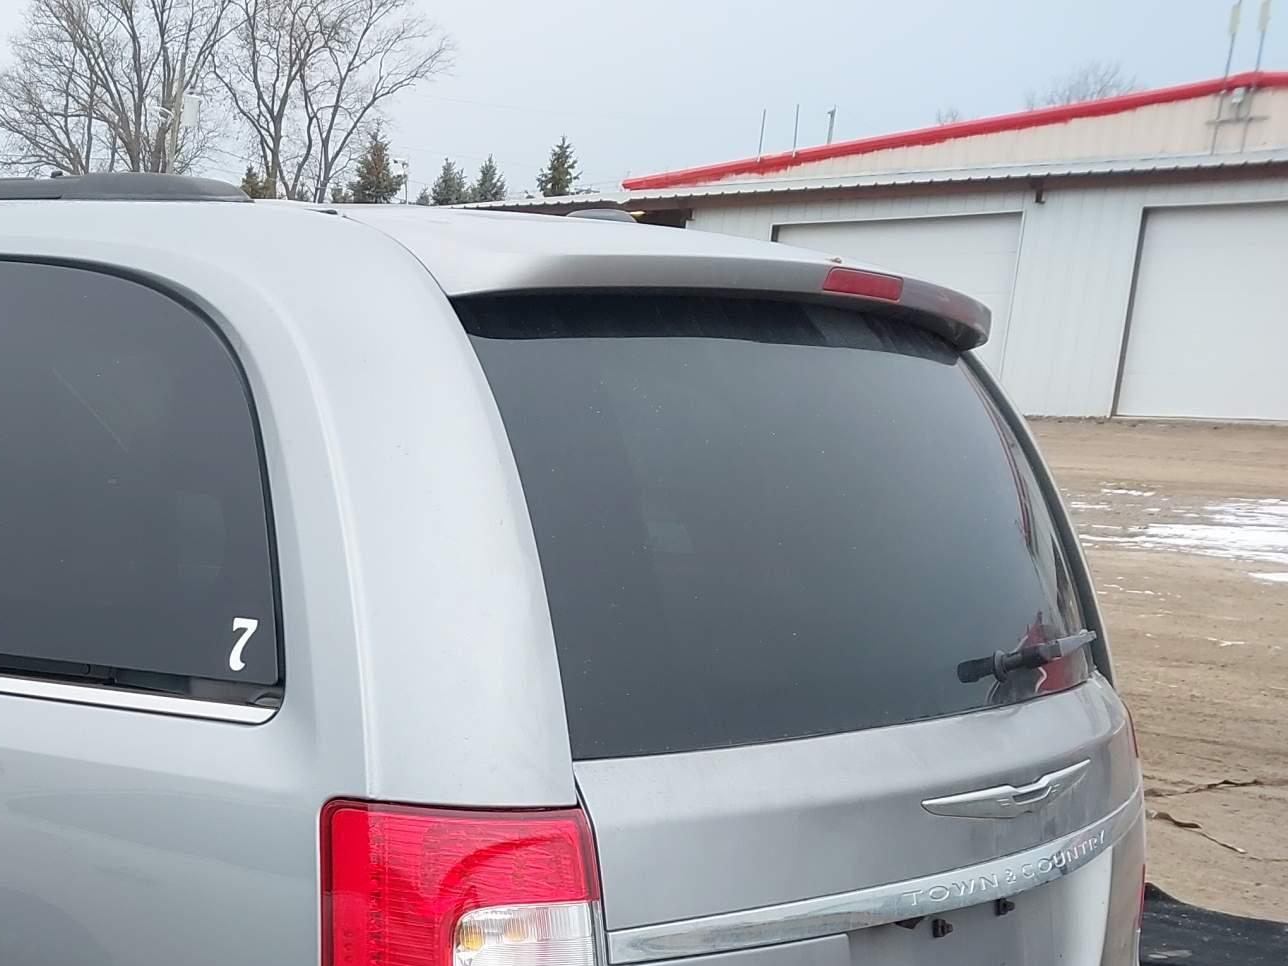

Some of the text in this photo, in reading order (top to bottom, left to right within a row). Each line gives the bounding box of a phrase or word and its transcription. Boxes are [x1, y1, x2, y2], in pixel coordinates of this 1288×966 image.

[229, 617, 259, 671] 7
[903, 872, 999, 906] TOWN
[1022, 830, 1106, 880] COUNTRY
